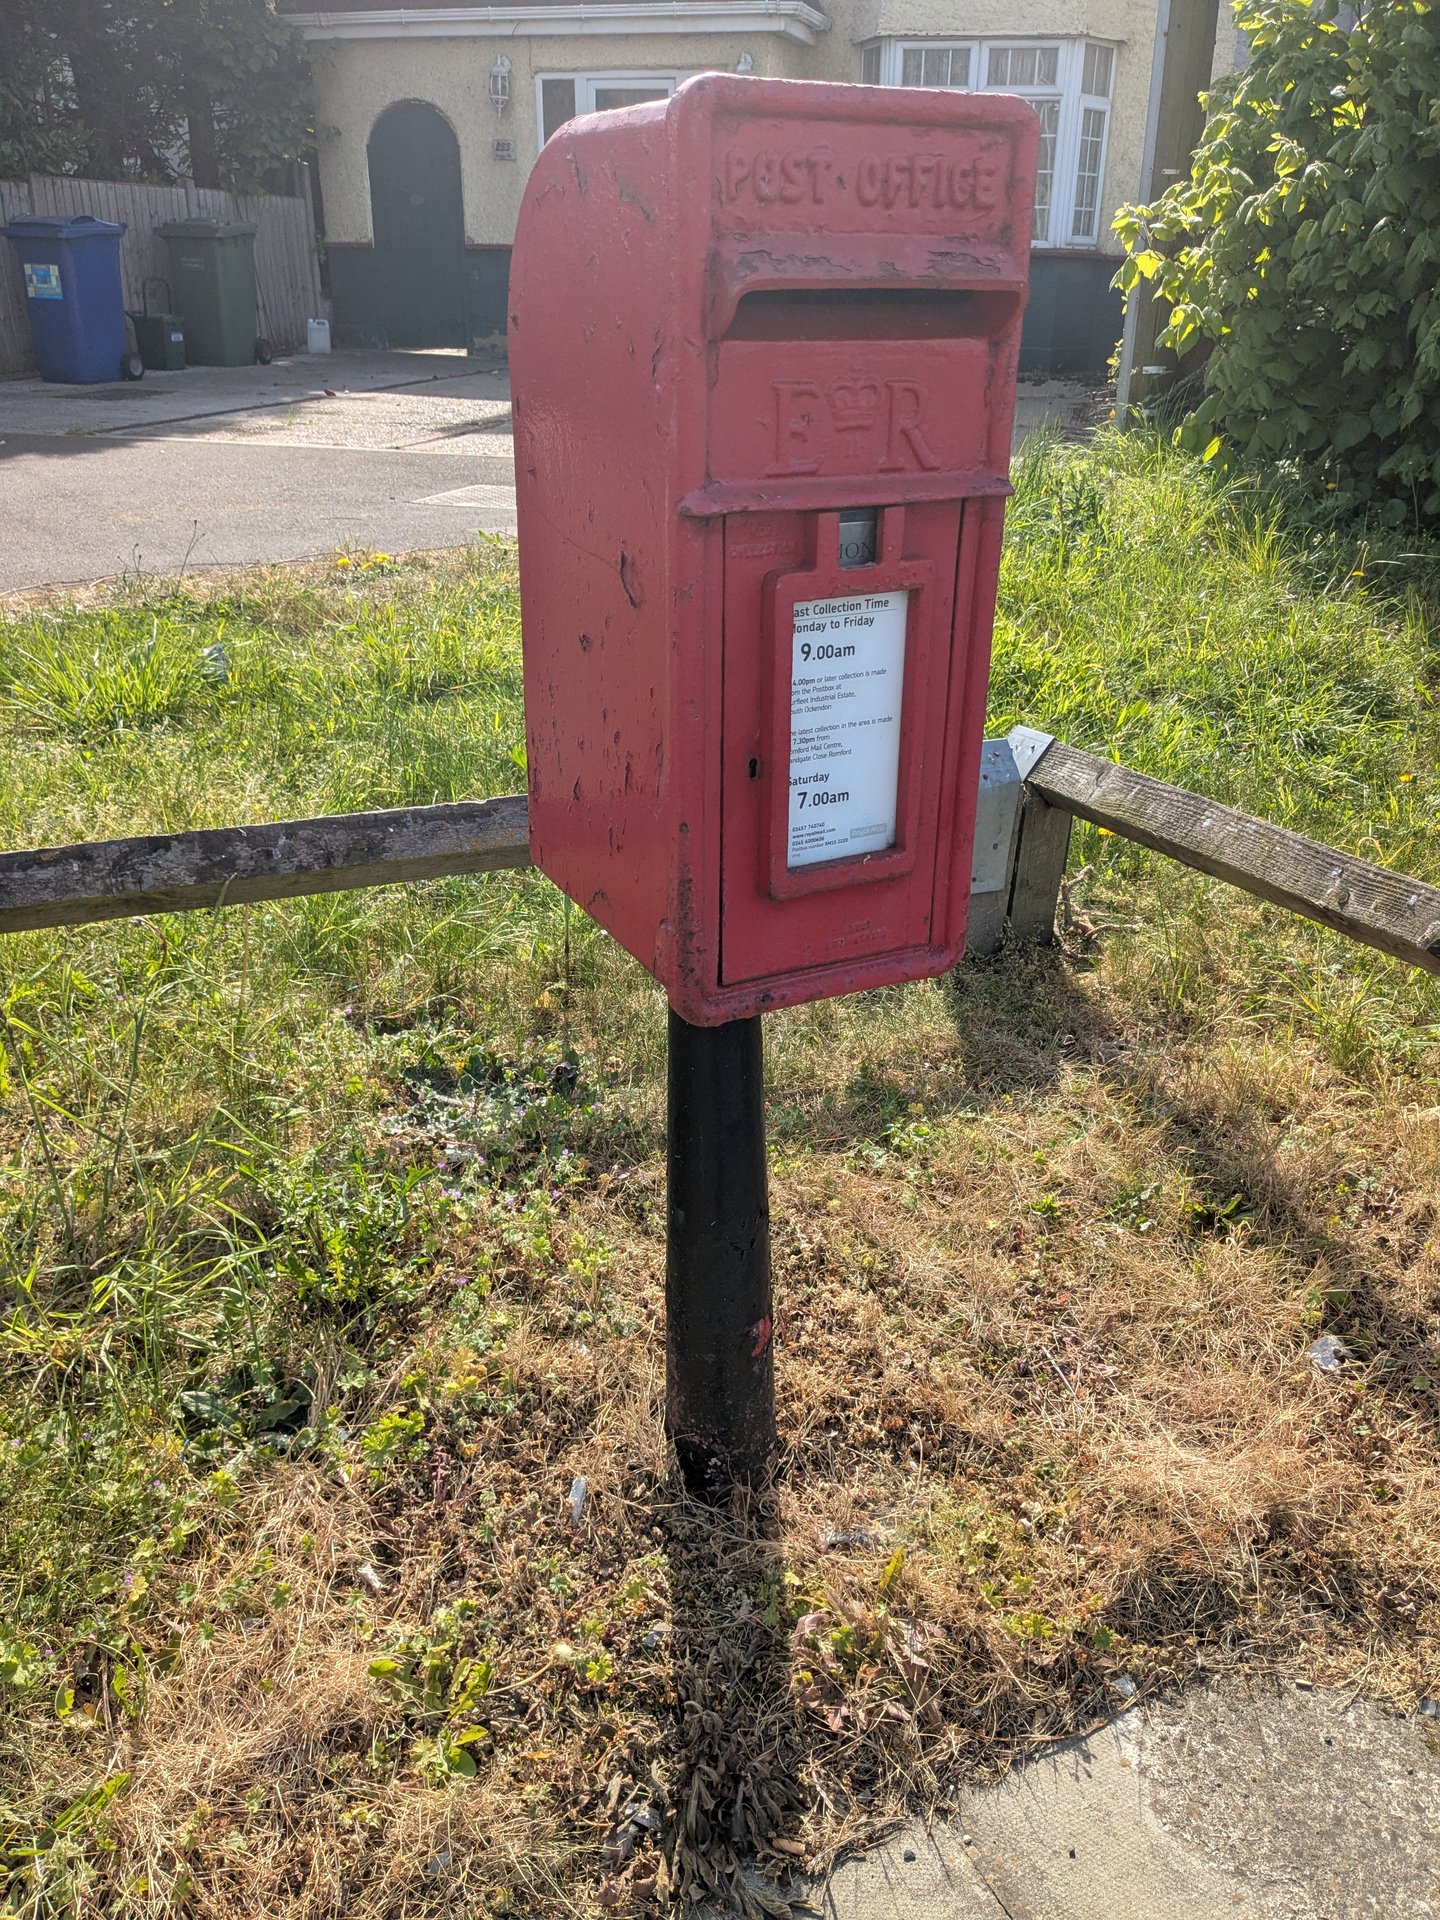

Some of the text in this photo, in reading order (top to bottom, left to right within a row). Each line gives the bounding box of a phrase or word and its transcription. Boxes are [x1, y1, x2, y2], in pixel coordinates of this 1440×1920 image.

[725, 147, 996, 210] POST OFFICE
[793, 598, 890, 618] ast Collection Time
[830, 619, 840, 630] to
[844, 616, 875, 628] Friday
[801, 642, 855, 662] 9.00am
[824, 675, 837, 683] later
[838, 670, 864, 681] collection
[871, 668, 887, 676] made
[801, 687, 811, 695] the
[812, 685, 835, 694] Postbox
[810, 693, 836, 703] Industrial
[790, 703, 832, 715] outh Ockendon
[814, 723, 840, 733] collection
[848, 719, 857, 727] the
[816, 734, 830, 742] from
[790, 745, 809, 755] omford
[810, 743, 822, 752] Mail
[790, 748, 852, 764] andgate Close Romford
[797, 791, 850, 810] 7.00am
